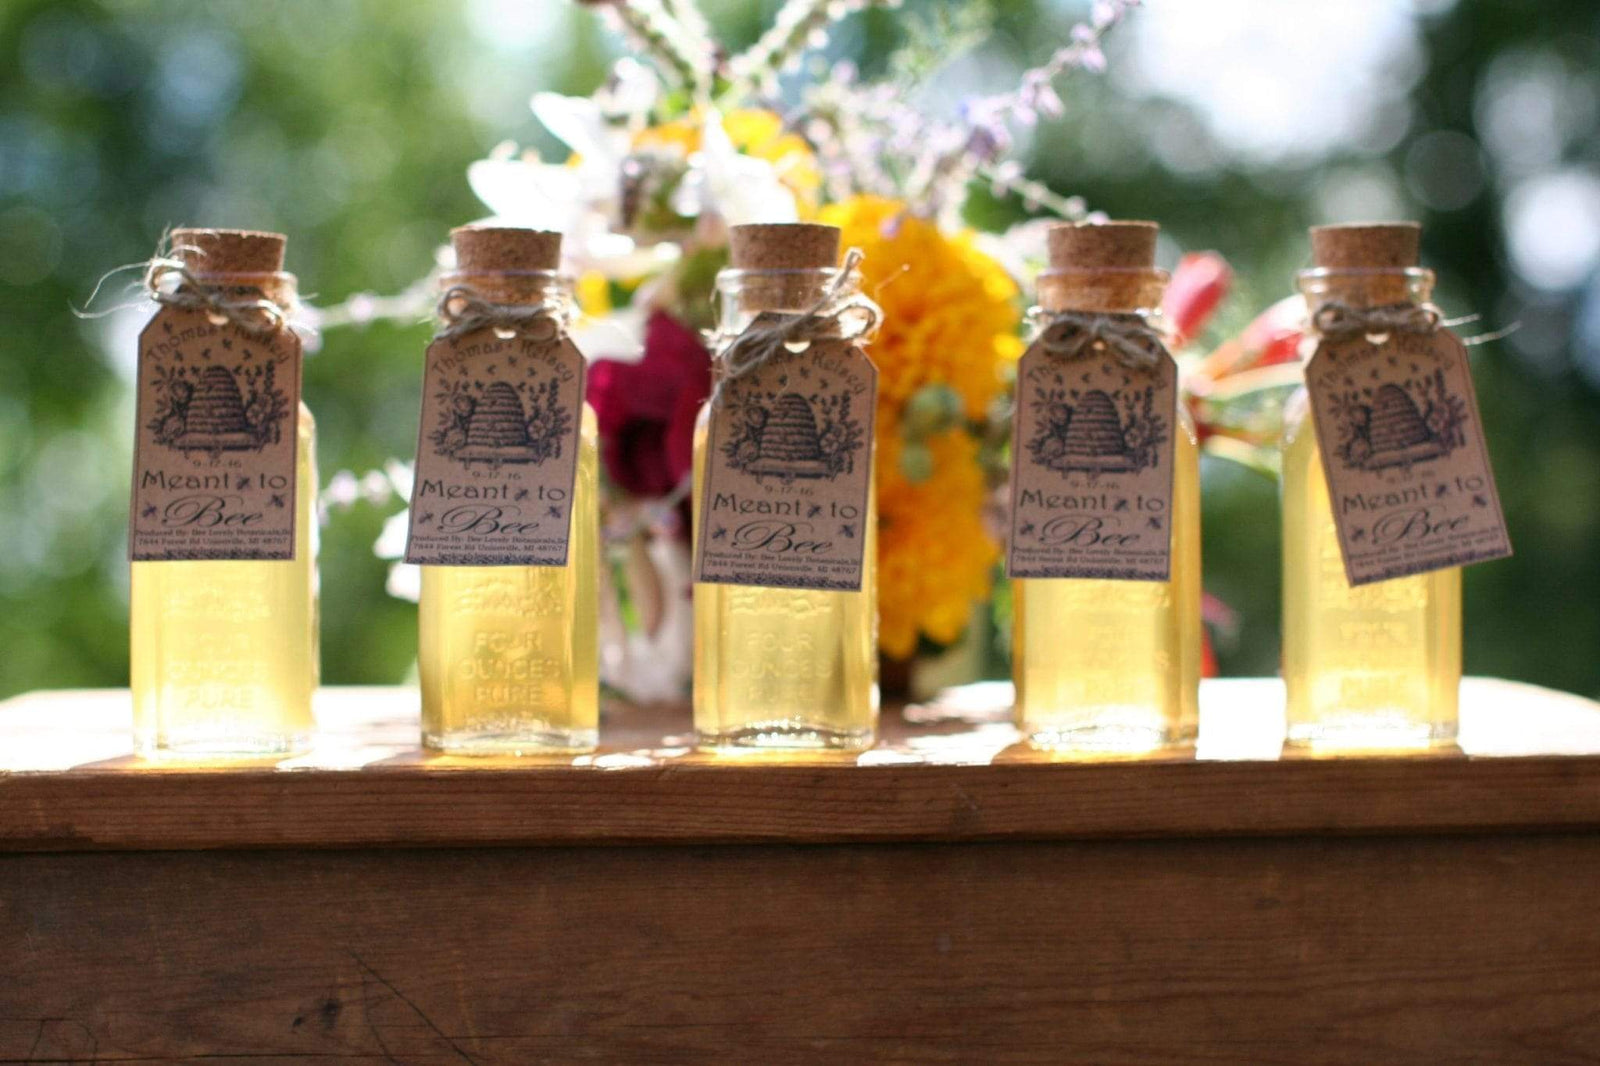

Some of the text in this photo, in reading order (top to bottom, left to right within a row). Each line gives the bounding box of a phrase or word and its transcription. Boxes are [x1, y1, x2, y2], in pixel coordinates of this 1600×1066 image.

[142, 470, 288, 492] Meant to
[419, 478, 566, 501] Meant to
[1342, 484, 1428, 514] Meant
[1454, 476, 1484, 492] to
[161, 494, 263, 528] Bee
[712, 492, 858, 519] Meant to
[1019, 488, 1164, 512] Meant to
[436, 503, 540, 535] Bee
[1038, 513, 1141, 547] Bee
[1371, 503, 1469, 545] Bee
[731, 519, 833, 553] Bee
